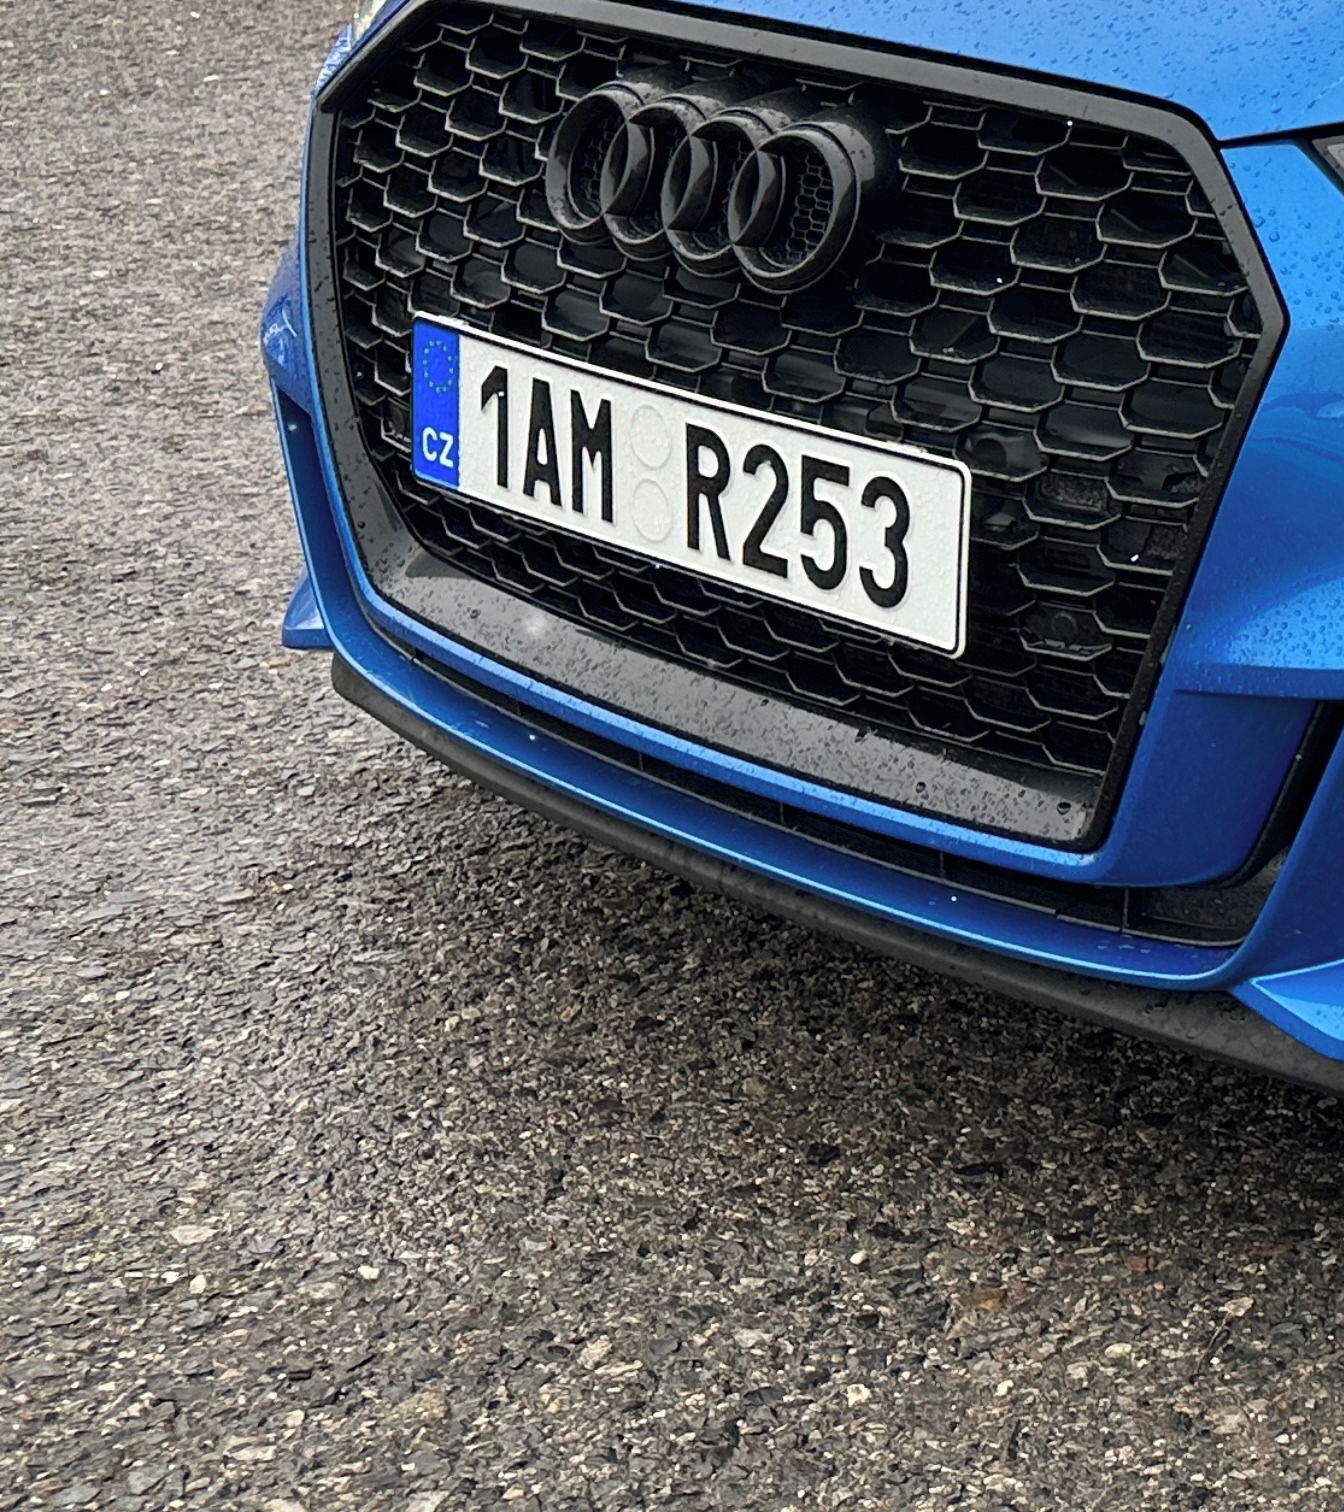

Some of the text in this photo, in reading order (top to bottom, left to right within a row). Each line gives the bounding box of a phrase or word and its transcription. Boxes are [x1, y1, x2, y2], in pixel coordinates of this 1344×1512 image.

[421, 424, 456, 469] CZ
[479, 365, 912, 609] 1AM R253
